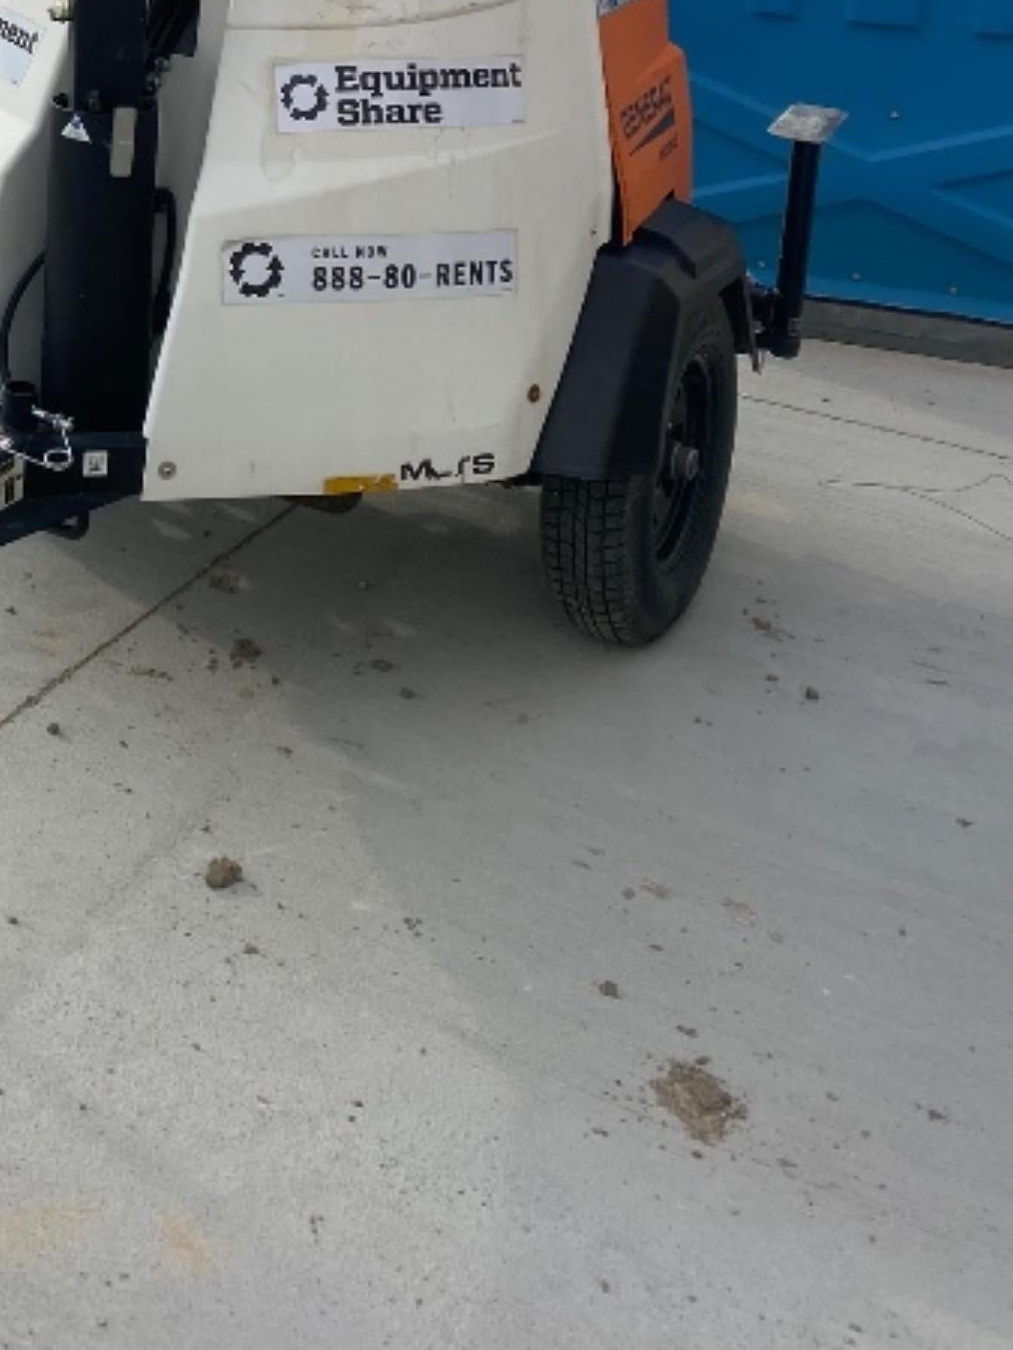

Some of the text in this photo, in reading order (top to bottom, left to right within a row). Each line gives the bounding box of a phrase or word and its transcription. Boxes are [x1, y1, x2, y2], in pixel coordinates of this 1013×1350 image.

[334, 61, 523, 99] Equipment
[336, 98, 443, 127] Share
[311, 258, 513, 291] 888-80-RENTS
